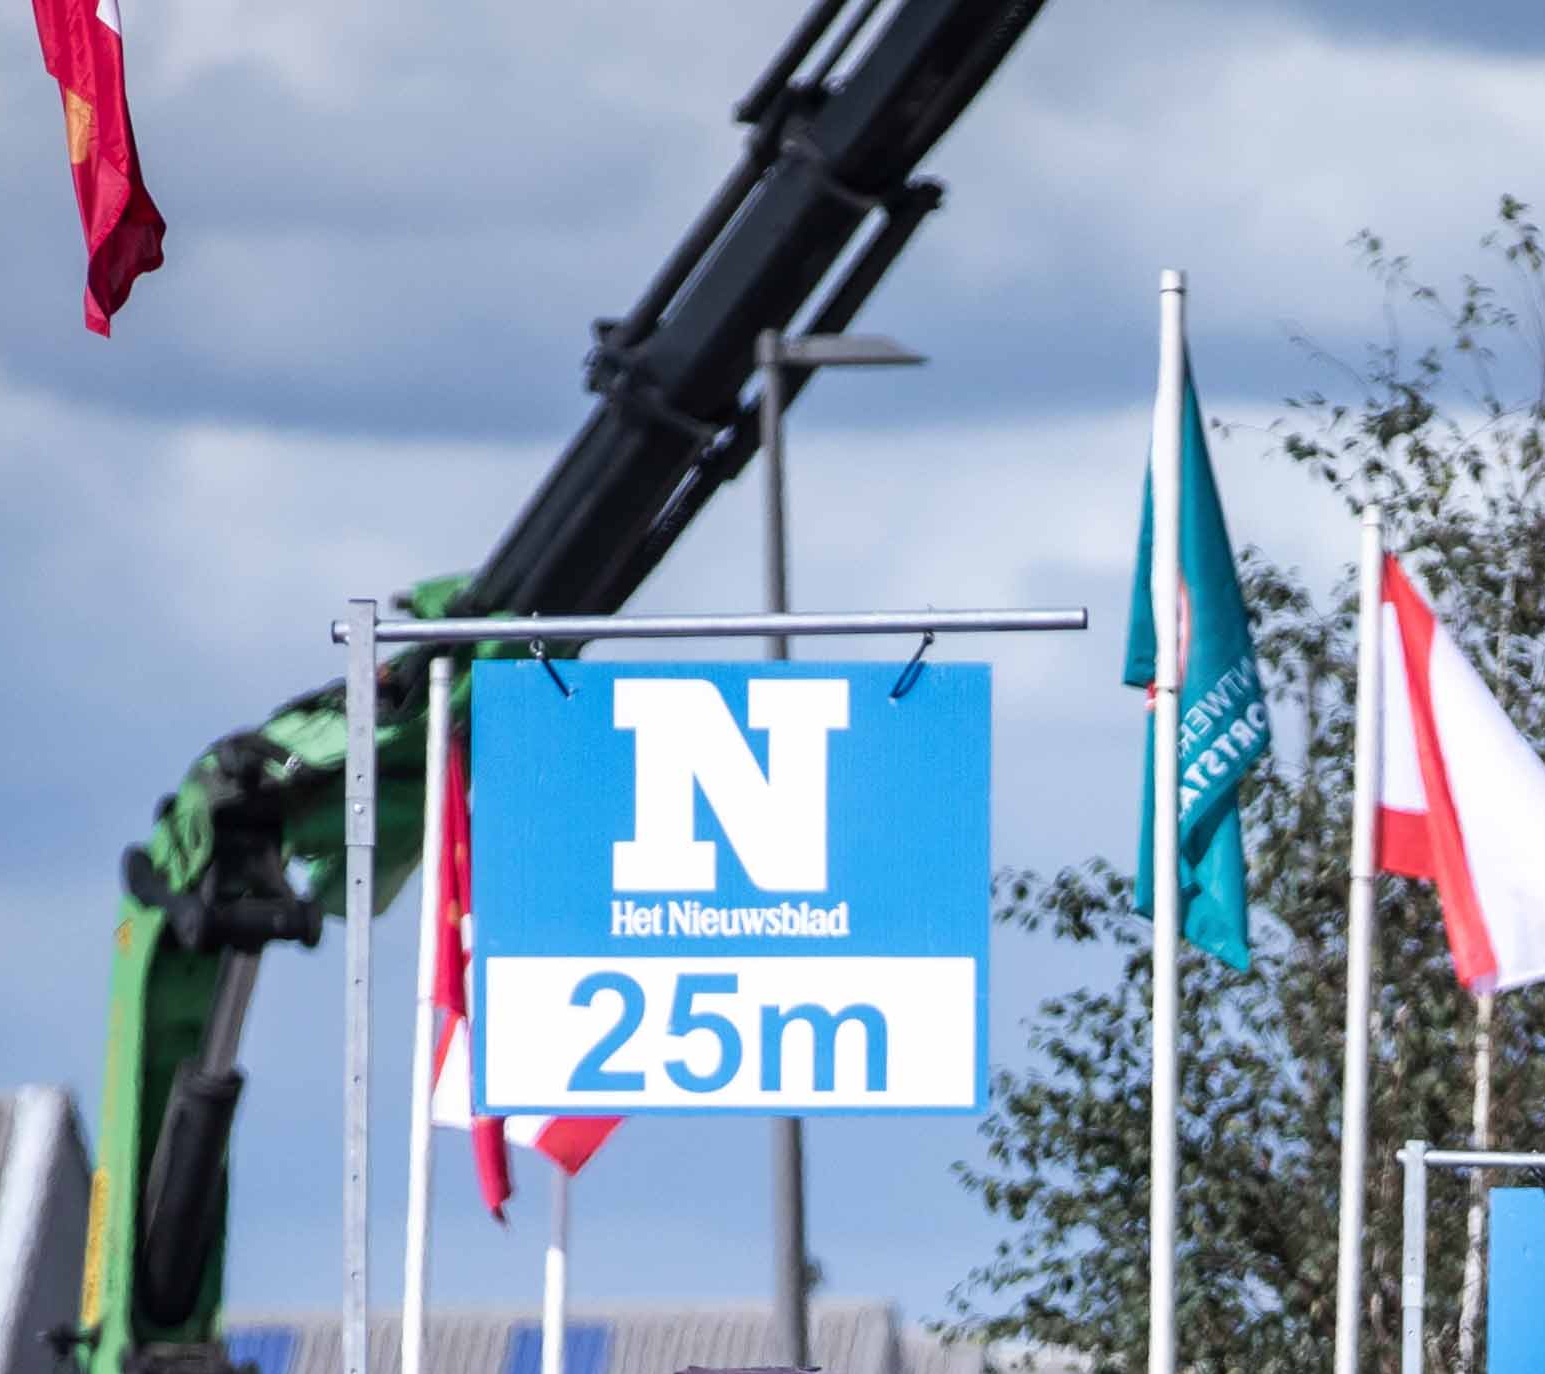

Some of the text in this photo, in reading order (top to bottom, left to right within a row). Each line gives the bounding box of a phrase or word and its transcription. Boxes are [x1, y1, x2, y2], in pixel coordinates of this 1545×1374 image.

[613, 678, 850, 892] N
[612, 899, 850, 937] Het Nieuwsblad
[566, 969, 889, 1095] 25m
